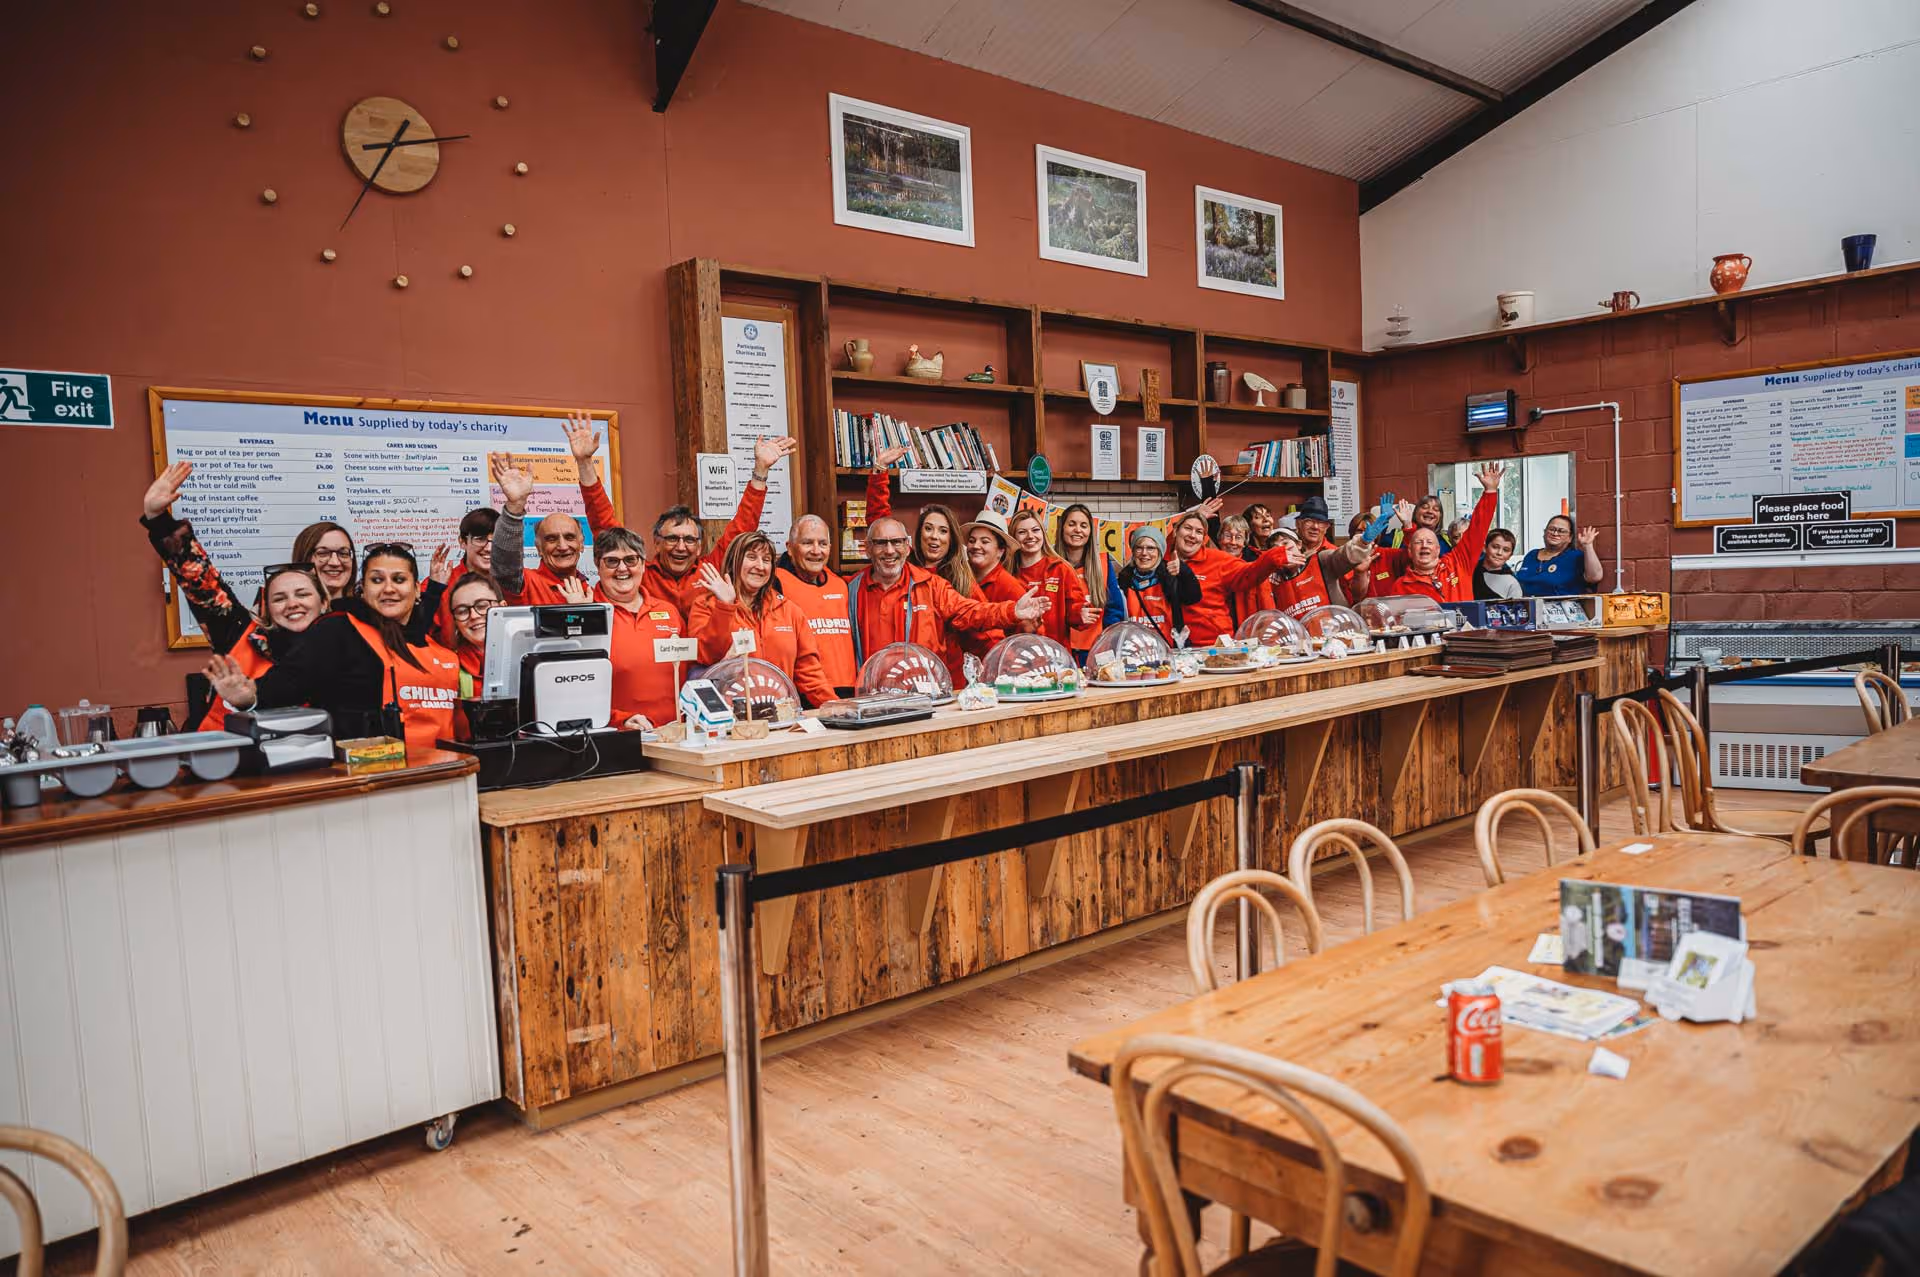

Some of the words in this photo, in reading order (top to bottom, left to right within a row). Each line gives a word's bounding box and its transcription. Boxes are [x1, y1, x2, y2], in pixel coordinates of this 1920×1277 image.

[1765, 375, 1799, 386] Menu
[1803, 370, 1841, 382] Supplied
[1844, 370, 1854, 380] by
[1857, 365, 1890, 376] today's
[1893, 361, 1920, 371] charit
[51, 381, 94, 399] Fire
[54, 401, 95, 418] exit
[304, 411, 354, 427] Menu
[359, 416, 409, 430] Supplied
[412, 418, 425, 431] by
[429, 420, 468, 432] today's
[471, 421, 508, 434] charity
[177, 449, 193, 457] Mug
[709, 466, 728, 475] WiFi
[207, 474, 232, 482] freshly
[234, 474, 260, 482] ground
[182, 507, 198, 515] Mug
[210, 507, 245, 515] speciality
[1760, 505, 1791, 514] Please
[1794, 504, 1819, 513] place
[1821, 502, 1844, 510] food
[1773, 513, 1805, 522] orders
[1807, 512, 1830, 520] here
[1105, 529, 1116, 552] C
[217, 552, 242, 560] squash
[808, 618, 850, 629] HILDREN
[554, 674, 596, 684] OKPOS
[399, 686, 458, 701] CHILDR
